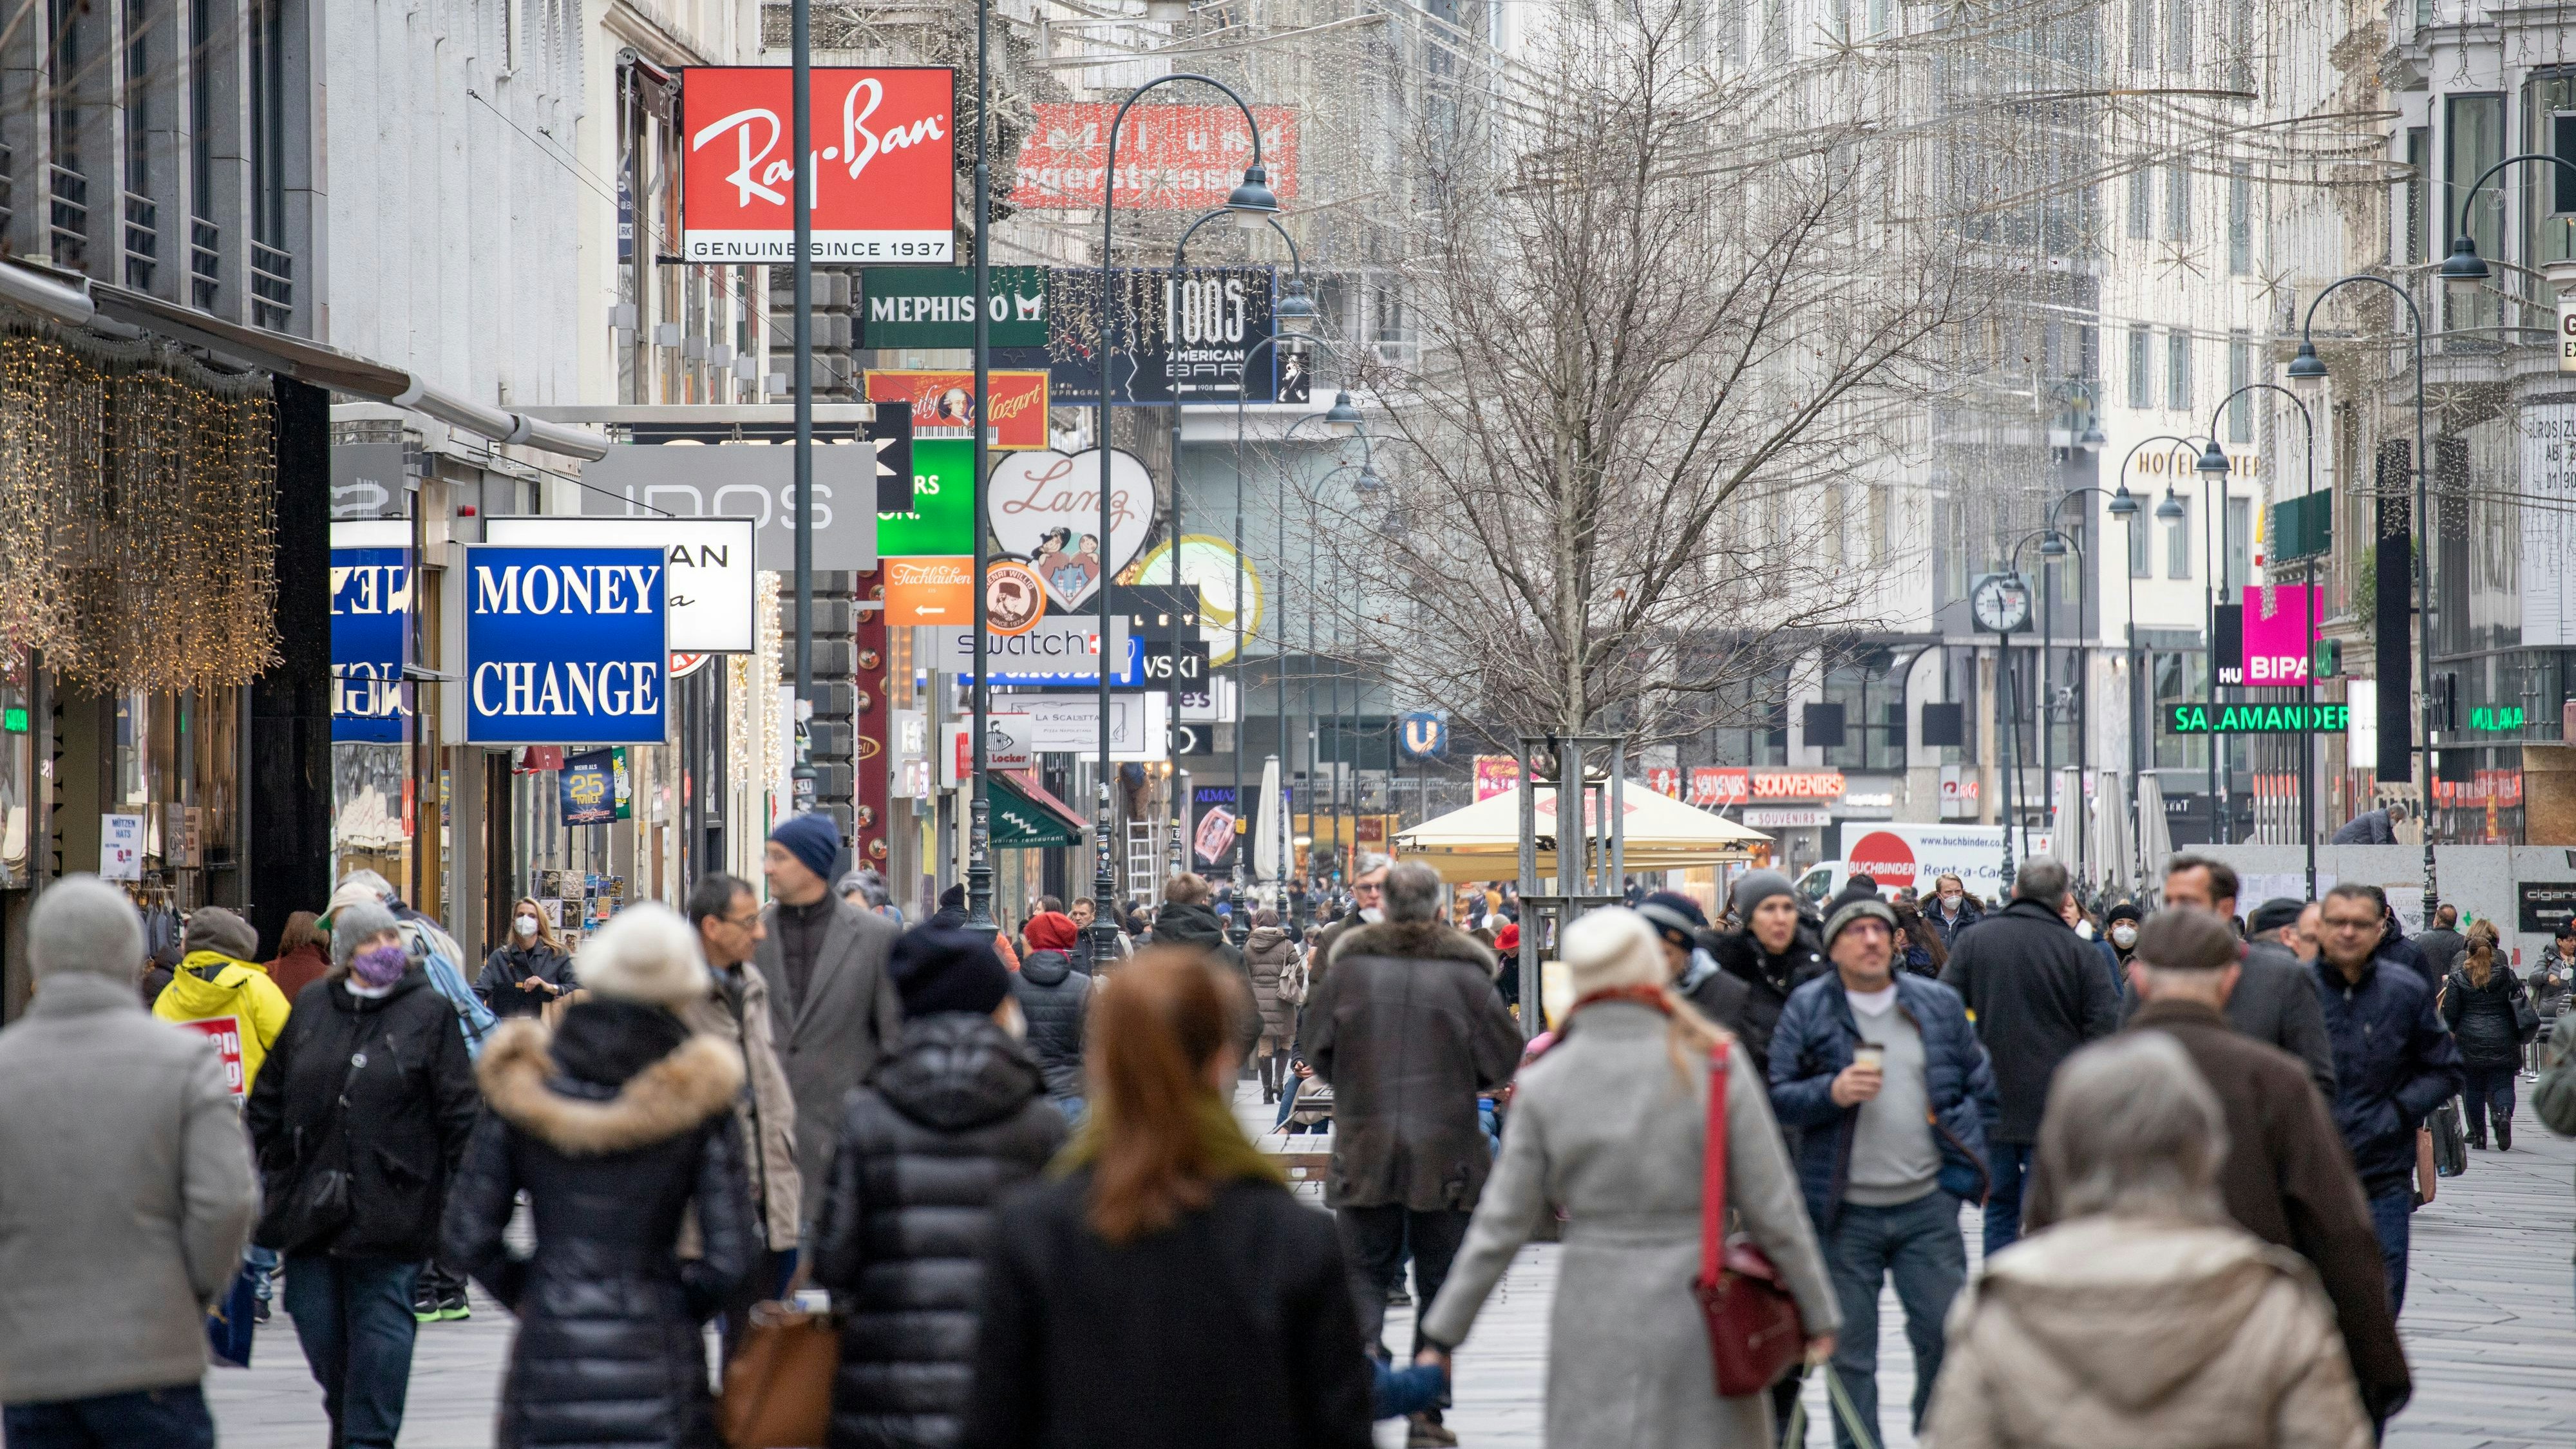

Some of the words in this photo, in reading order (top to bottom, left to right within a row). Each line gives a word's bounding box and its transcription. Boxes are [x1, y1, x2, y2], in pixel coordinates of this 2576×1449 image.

[891, 243, 945, 256] 1937
[871, 296, 1009, 322] MEPHISO
[1167, 350, 1244, 362] AMERICAN
[2565, 342, 2576, 357] E
[1166, 364, 1243, 377] BAR
[2138, 452, 2197, 475] HOEL
[891, 564, 972, 585] Tuchlauben
[1009, 570, 1034, 591] WILLIG
[475, 565, 660, 615] MONEY
[991, 617, 1009, 628] SINCE
[1010, 618, 1025, 628] 1974
[957, 630, 1084, 655] swatch
[2219, 667, 2242, 683] HU
[2250, 656, 2308, 679] BIPA
[473, 661, 659, 716] CHANGE
[1406, 721, 1438, 752] U
[992, 753, 1027, 762] Locker
[569, 773, 605, 799] 25
[1696, 774, 1746, 797] SOUVENIRS
[1753, 773, 1845, 797] SOUVENIRS
[112, 818, 136, 828] MÜTZEN
[1758, 813, 1815, 824] SOUVENIRS
[116, 829, 131, 838] HATS
[1849, 862, 1915, 876] BUCHBINDER
